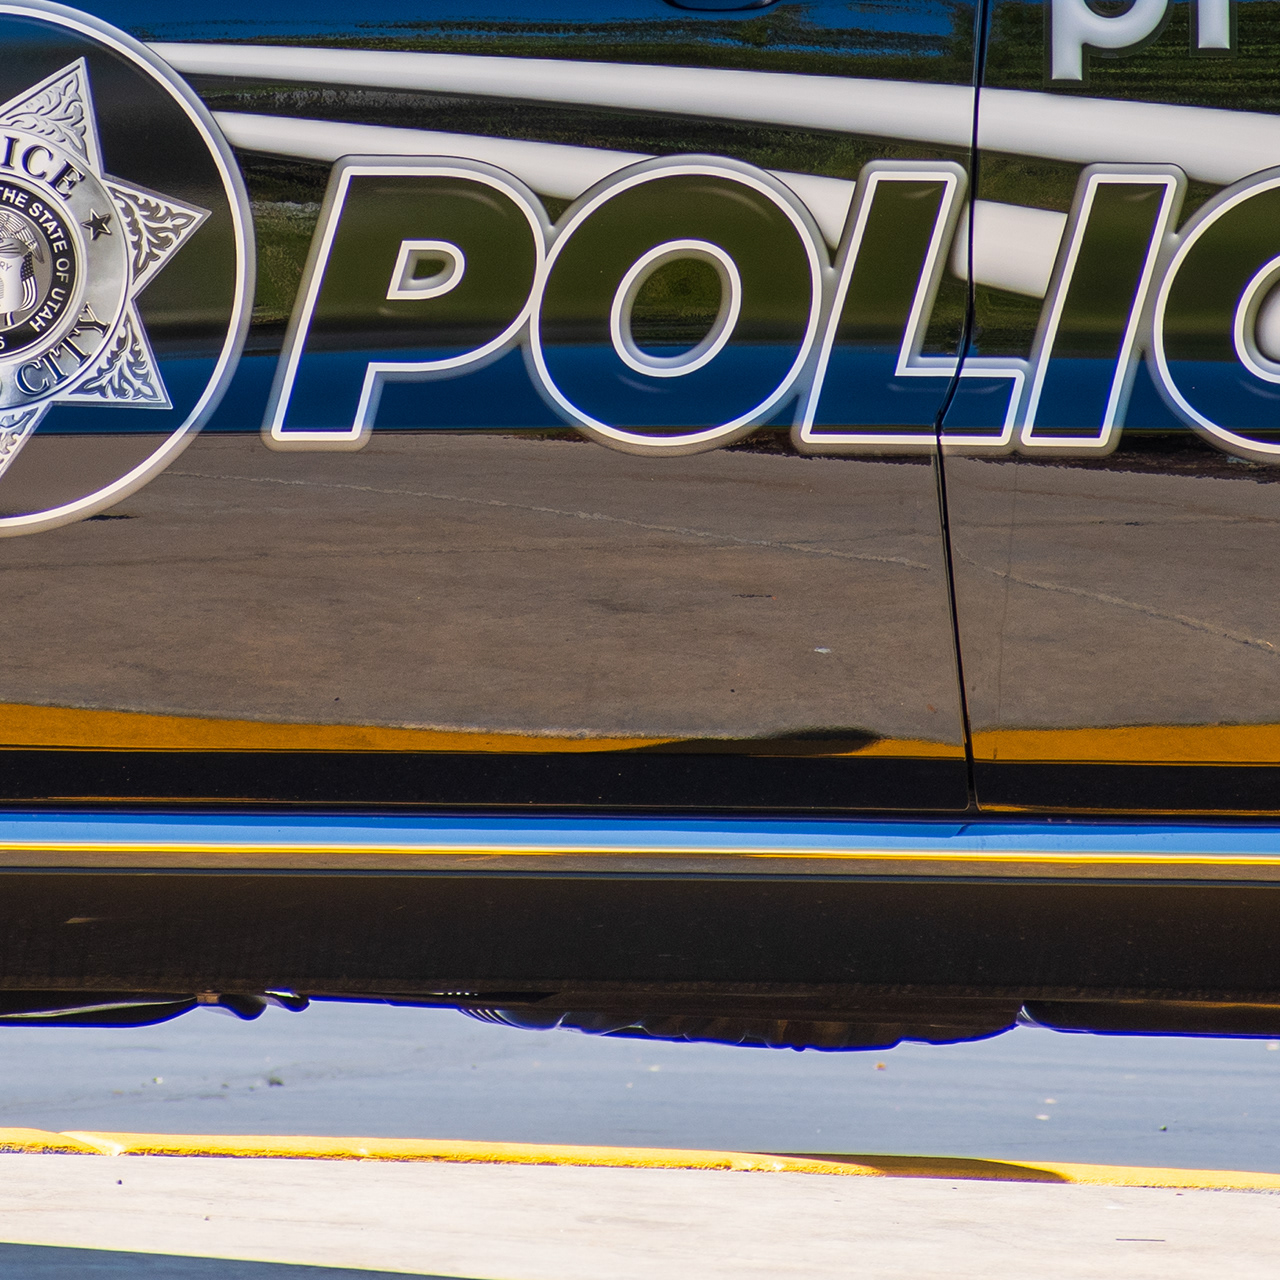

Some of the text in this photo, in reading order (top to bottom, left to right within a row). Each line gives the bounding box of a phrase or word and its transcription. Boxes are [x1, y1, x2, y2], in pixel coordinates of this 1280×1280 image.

[28, 202, 68, 254] STATE
[55, 257, 70, 283] OF
[29, 288, 66, 332] UTAH
[16, 302, 111, 395] CITY
